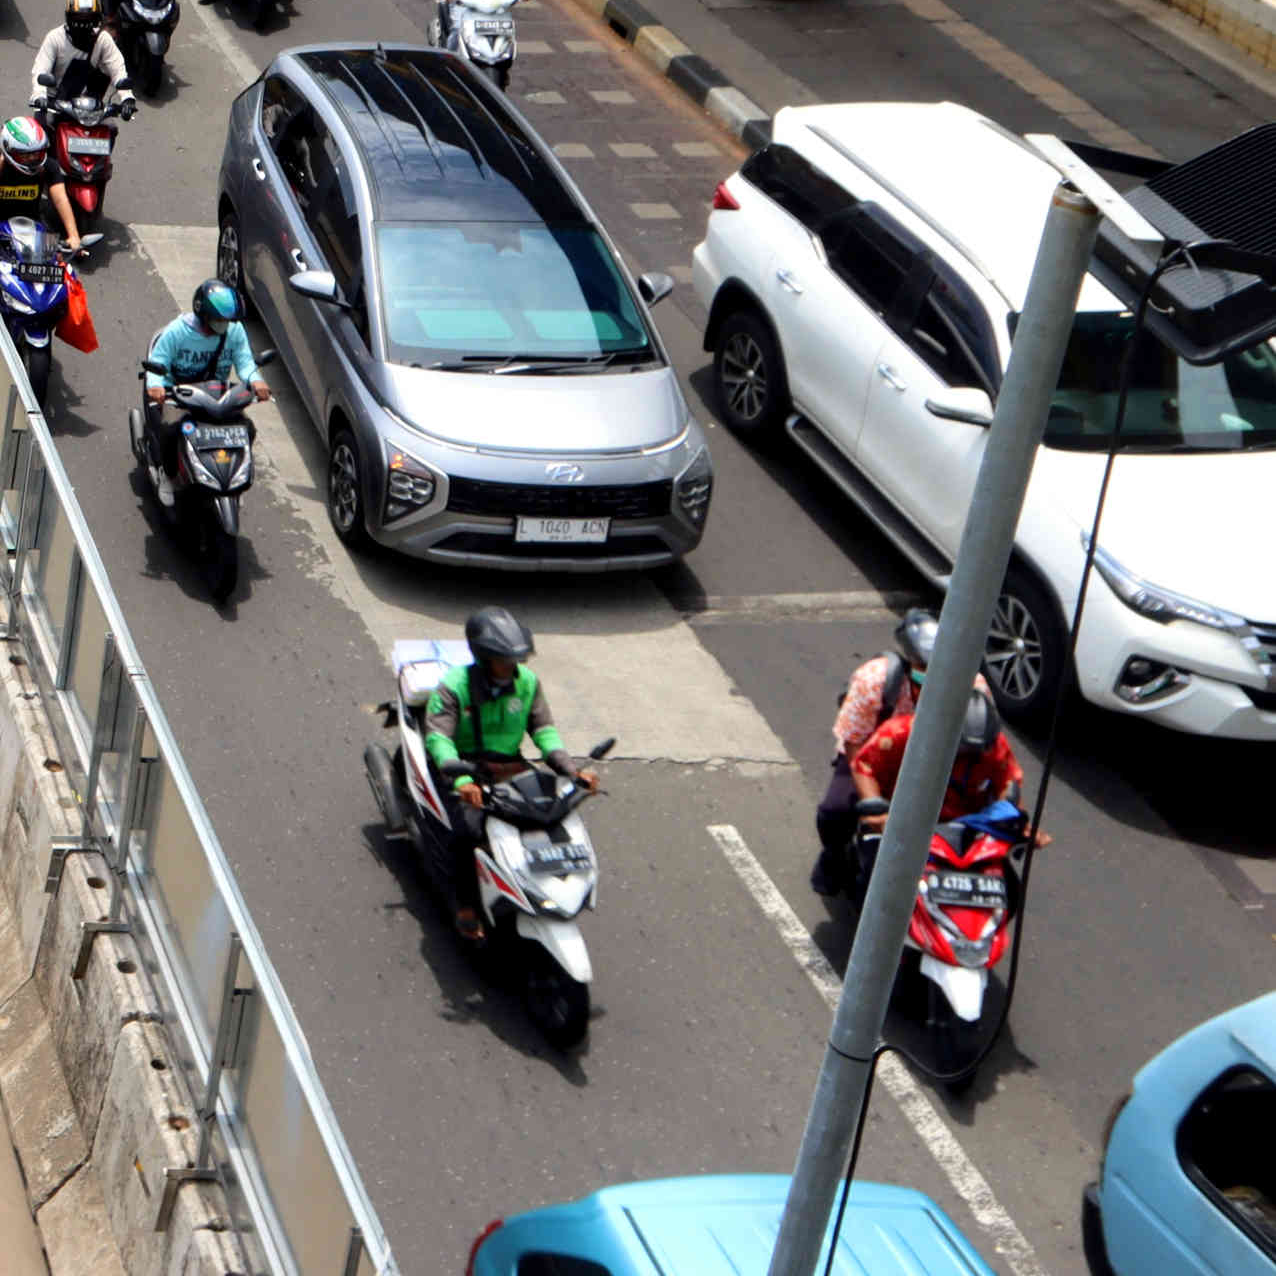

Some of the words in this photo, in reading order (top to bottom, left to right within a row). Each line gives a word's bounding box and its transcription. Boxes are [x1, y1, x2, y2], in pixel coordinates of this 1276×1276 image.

[519, 521, 528, 533] L
[539, 520, 570, 533] 1040
[582, 520, 606, 534] ACN
